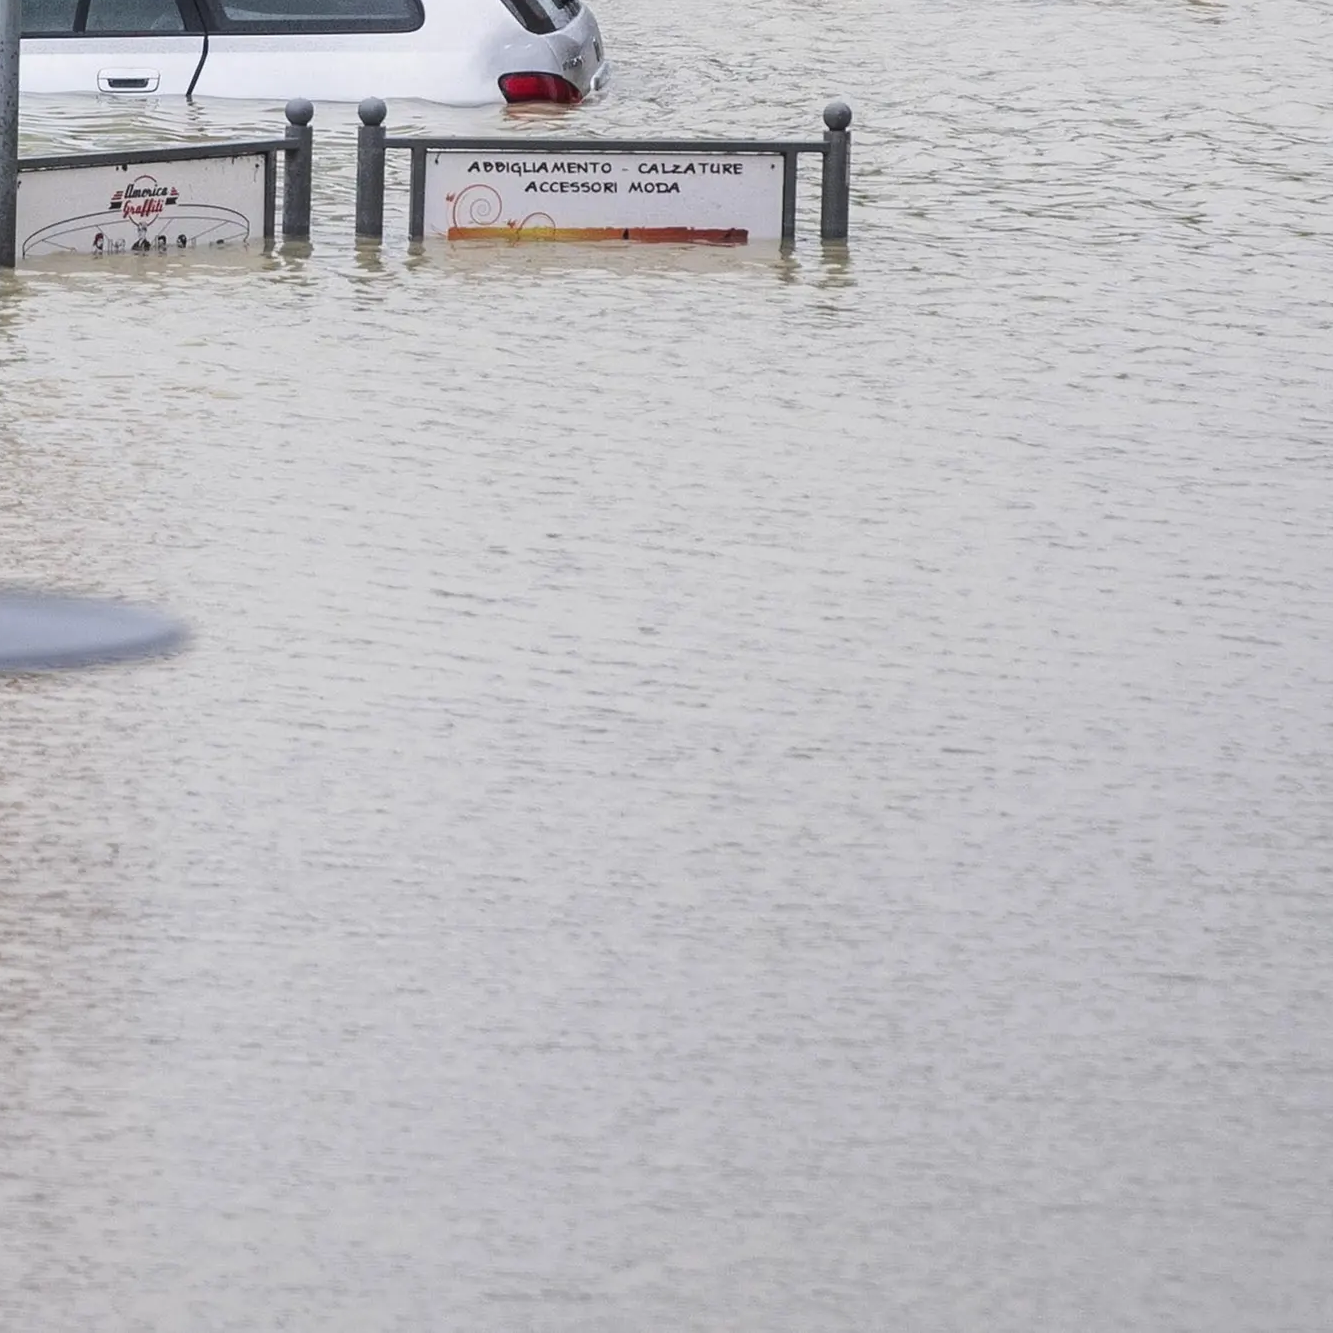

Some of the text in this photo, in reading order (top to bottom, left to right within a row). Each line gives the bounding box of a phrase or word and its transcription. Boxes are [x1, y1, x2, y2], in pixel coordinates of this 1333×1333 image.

[467, 161, 612, 177] ABBIGLIAMENTO
[637, 162, 743, 175] CALZATURE
[124, 183, 168, 198] America
[524, 181, 681, 194] ACCESSORI MODA
[123, 198, 164, 219] Graffiti
